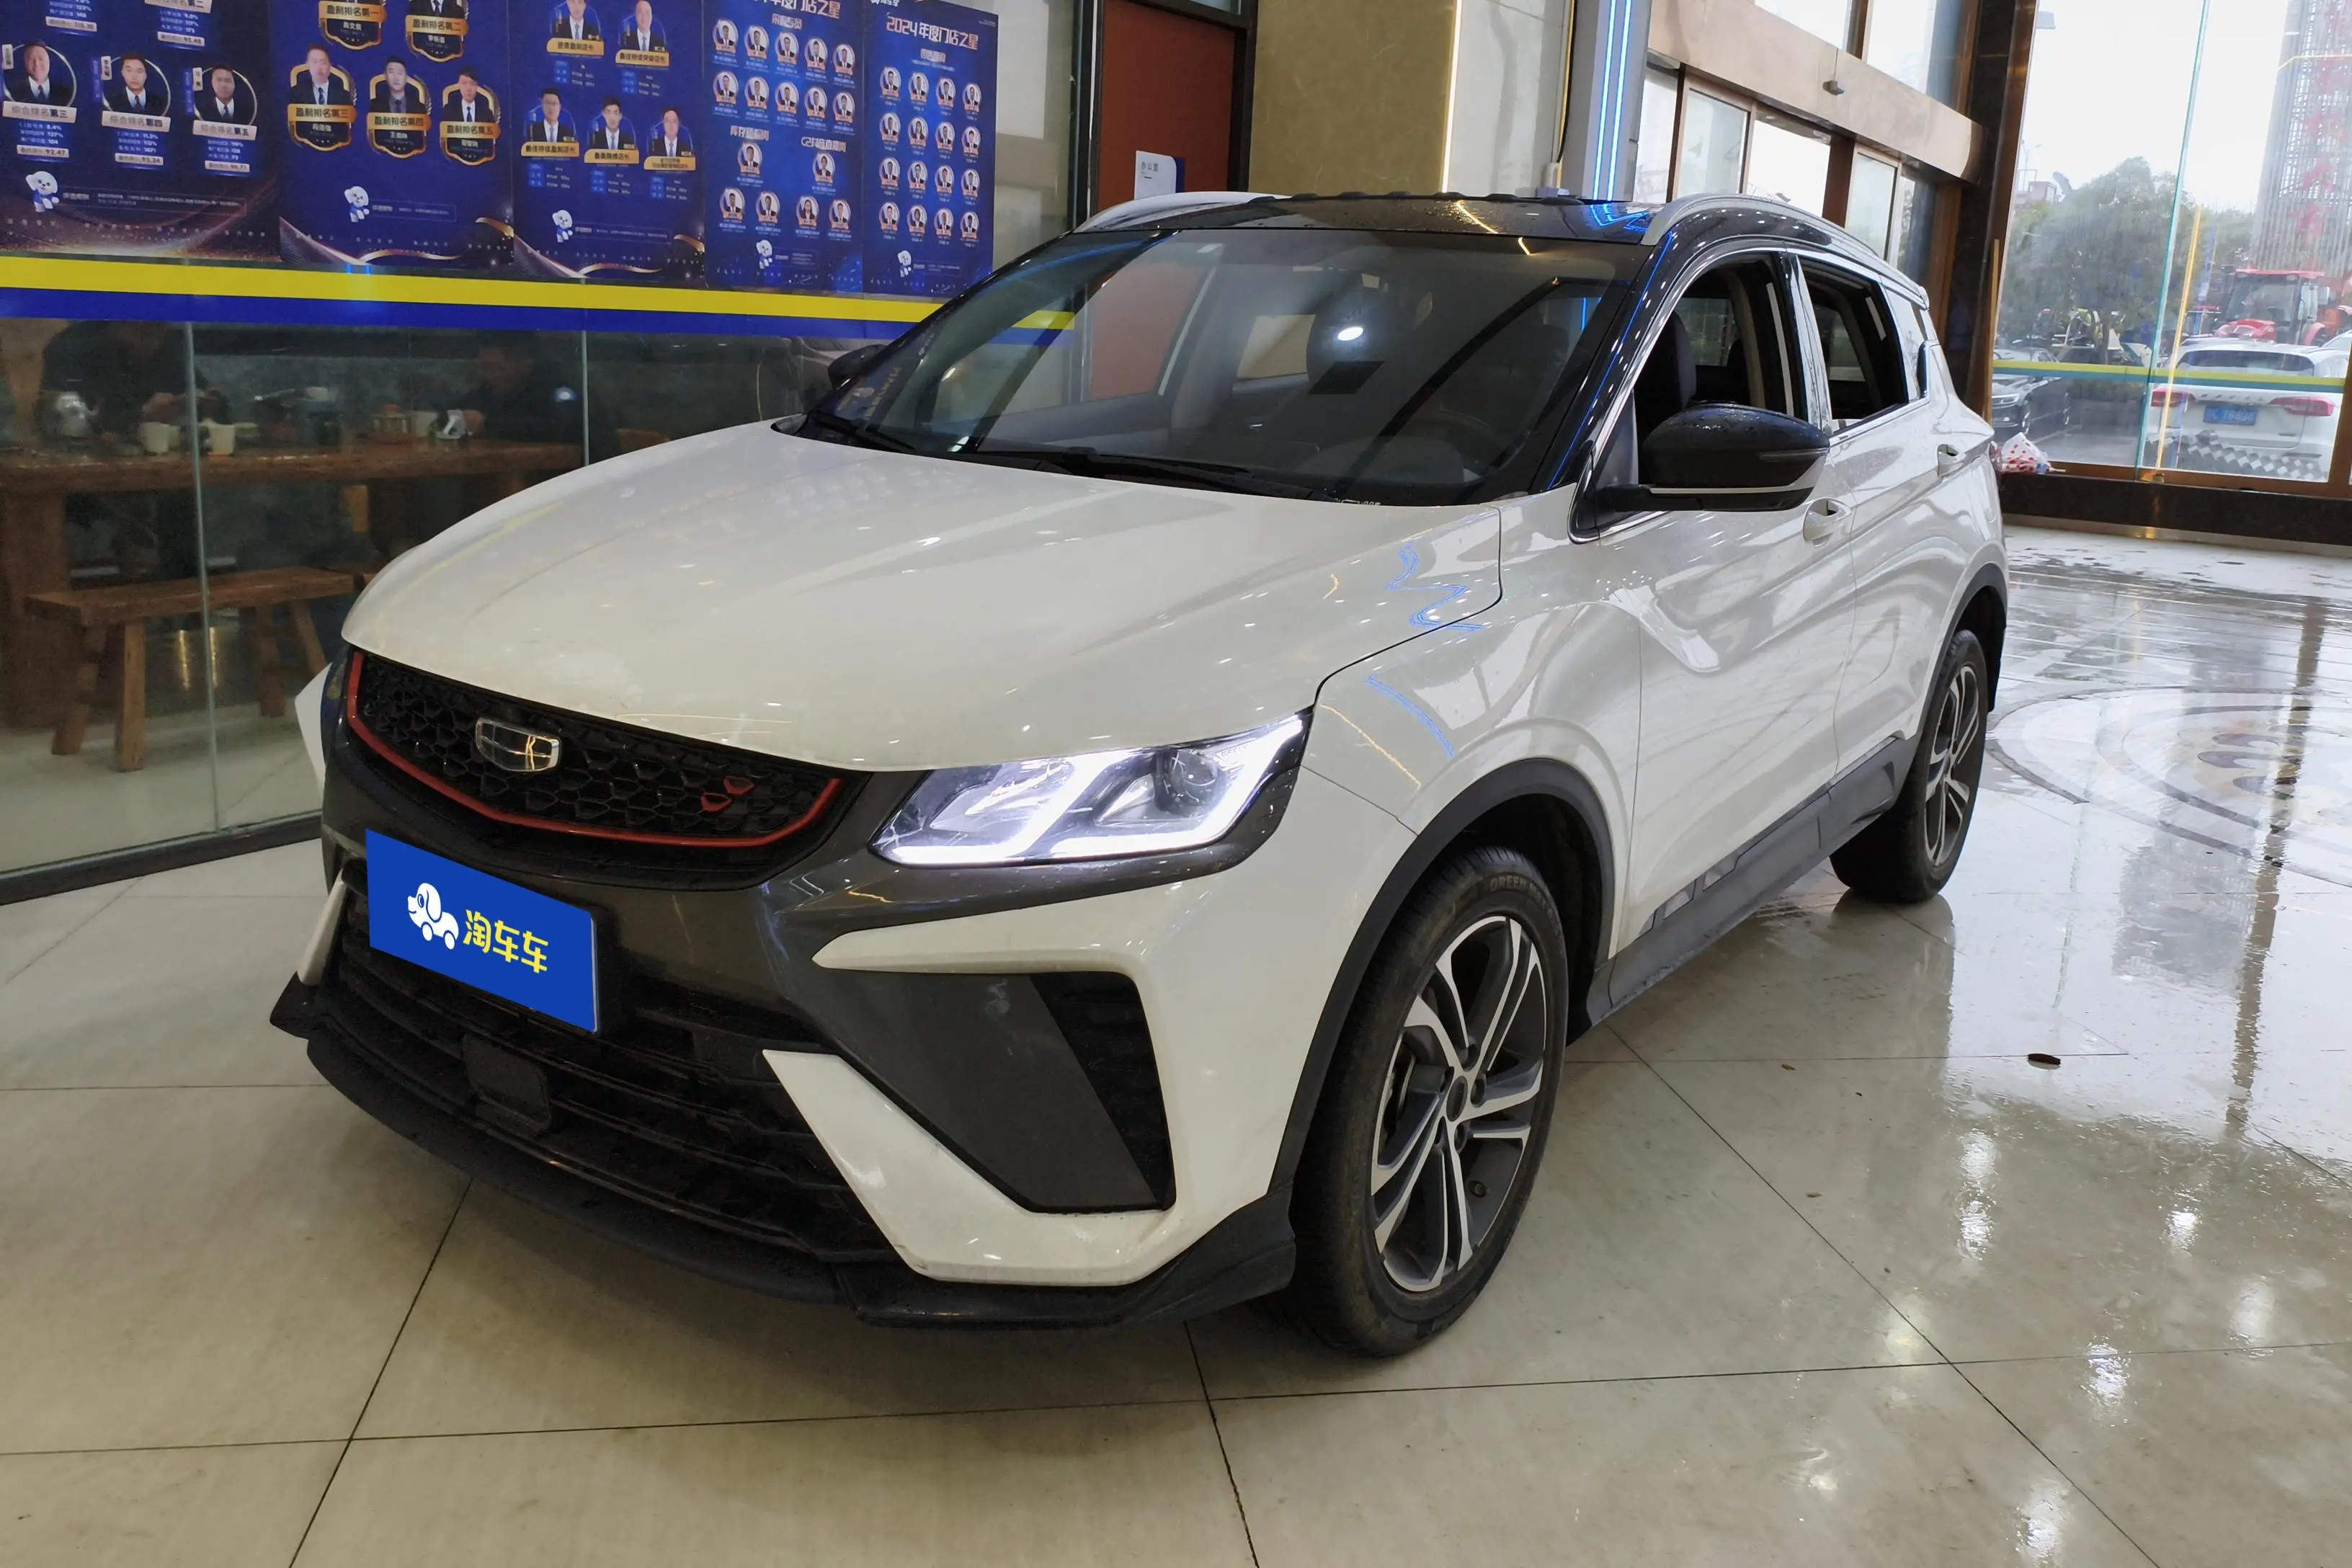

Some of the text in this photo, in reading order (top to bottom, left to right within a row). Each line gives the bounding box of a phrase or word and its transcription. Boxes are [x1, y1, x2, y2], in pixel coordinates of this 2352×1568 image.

[886, 16, 979, 50] 2024 年度门店之星
